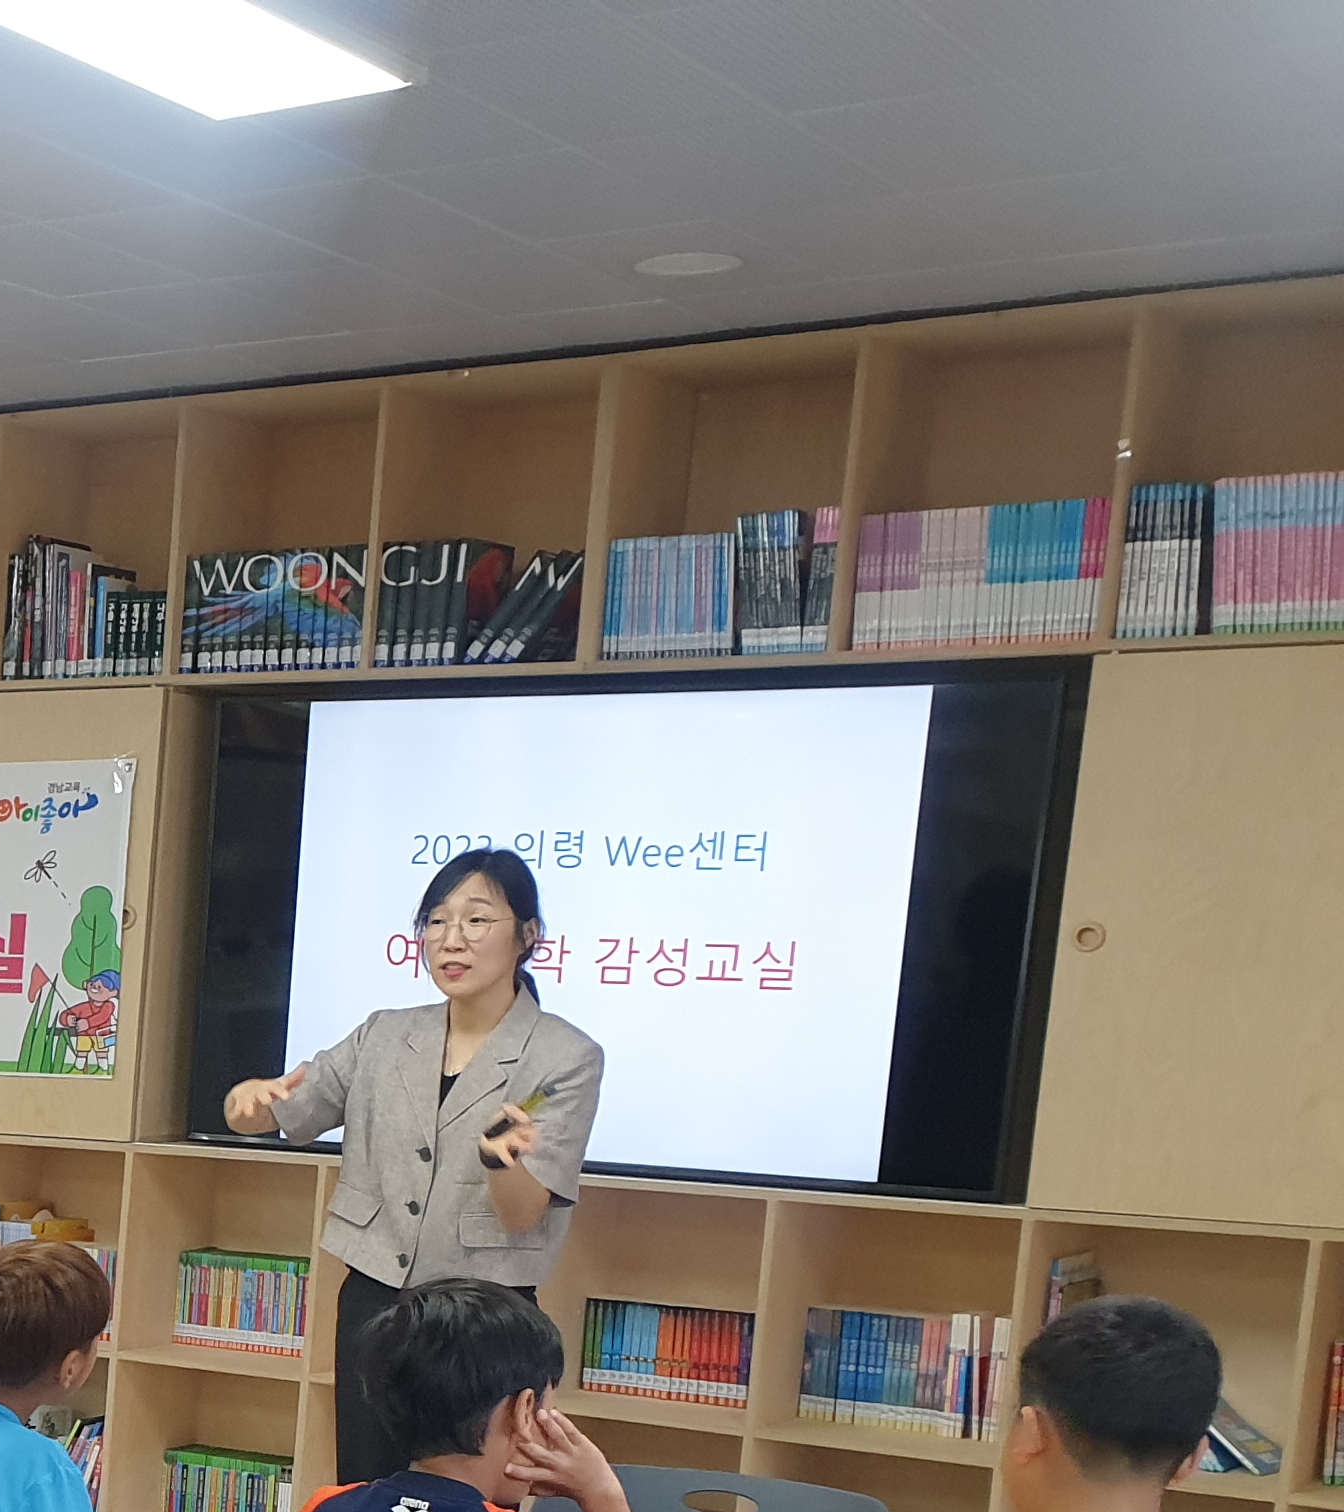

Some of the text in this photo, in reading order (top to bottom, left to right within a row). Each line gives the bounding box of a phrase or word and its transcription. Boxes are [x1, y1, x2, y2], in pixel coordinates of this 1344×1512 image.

[514, 830, 584, 869] 의령
[604, 829, 769, 872] Wee센터
[386, 934, 798, 991] 여학 감성교실
[400, 1497, 430, 1510] arena
